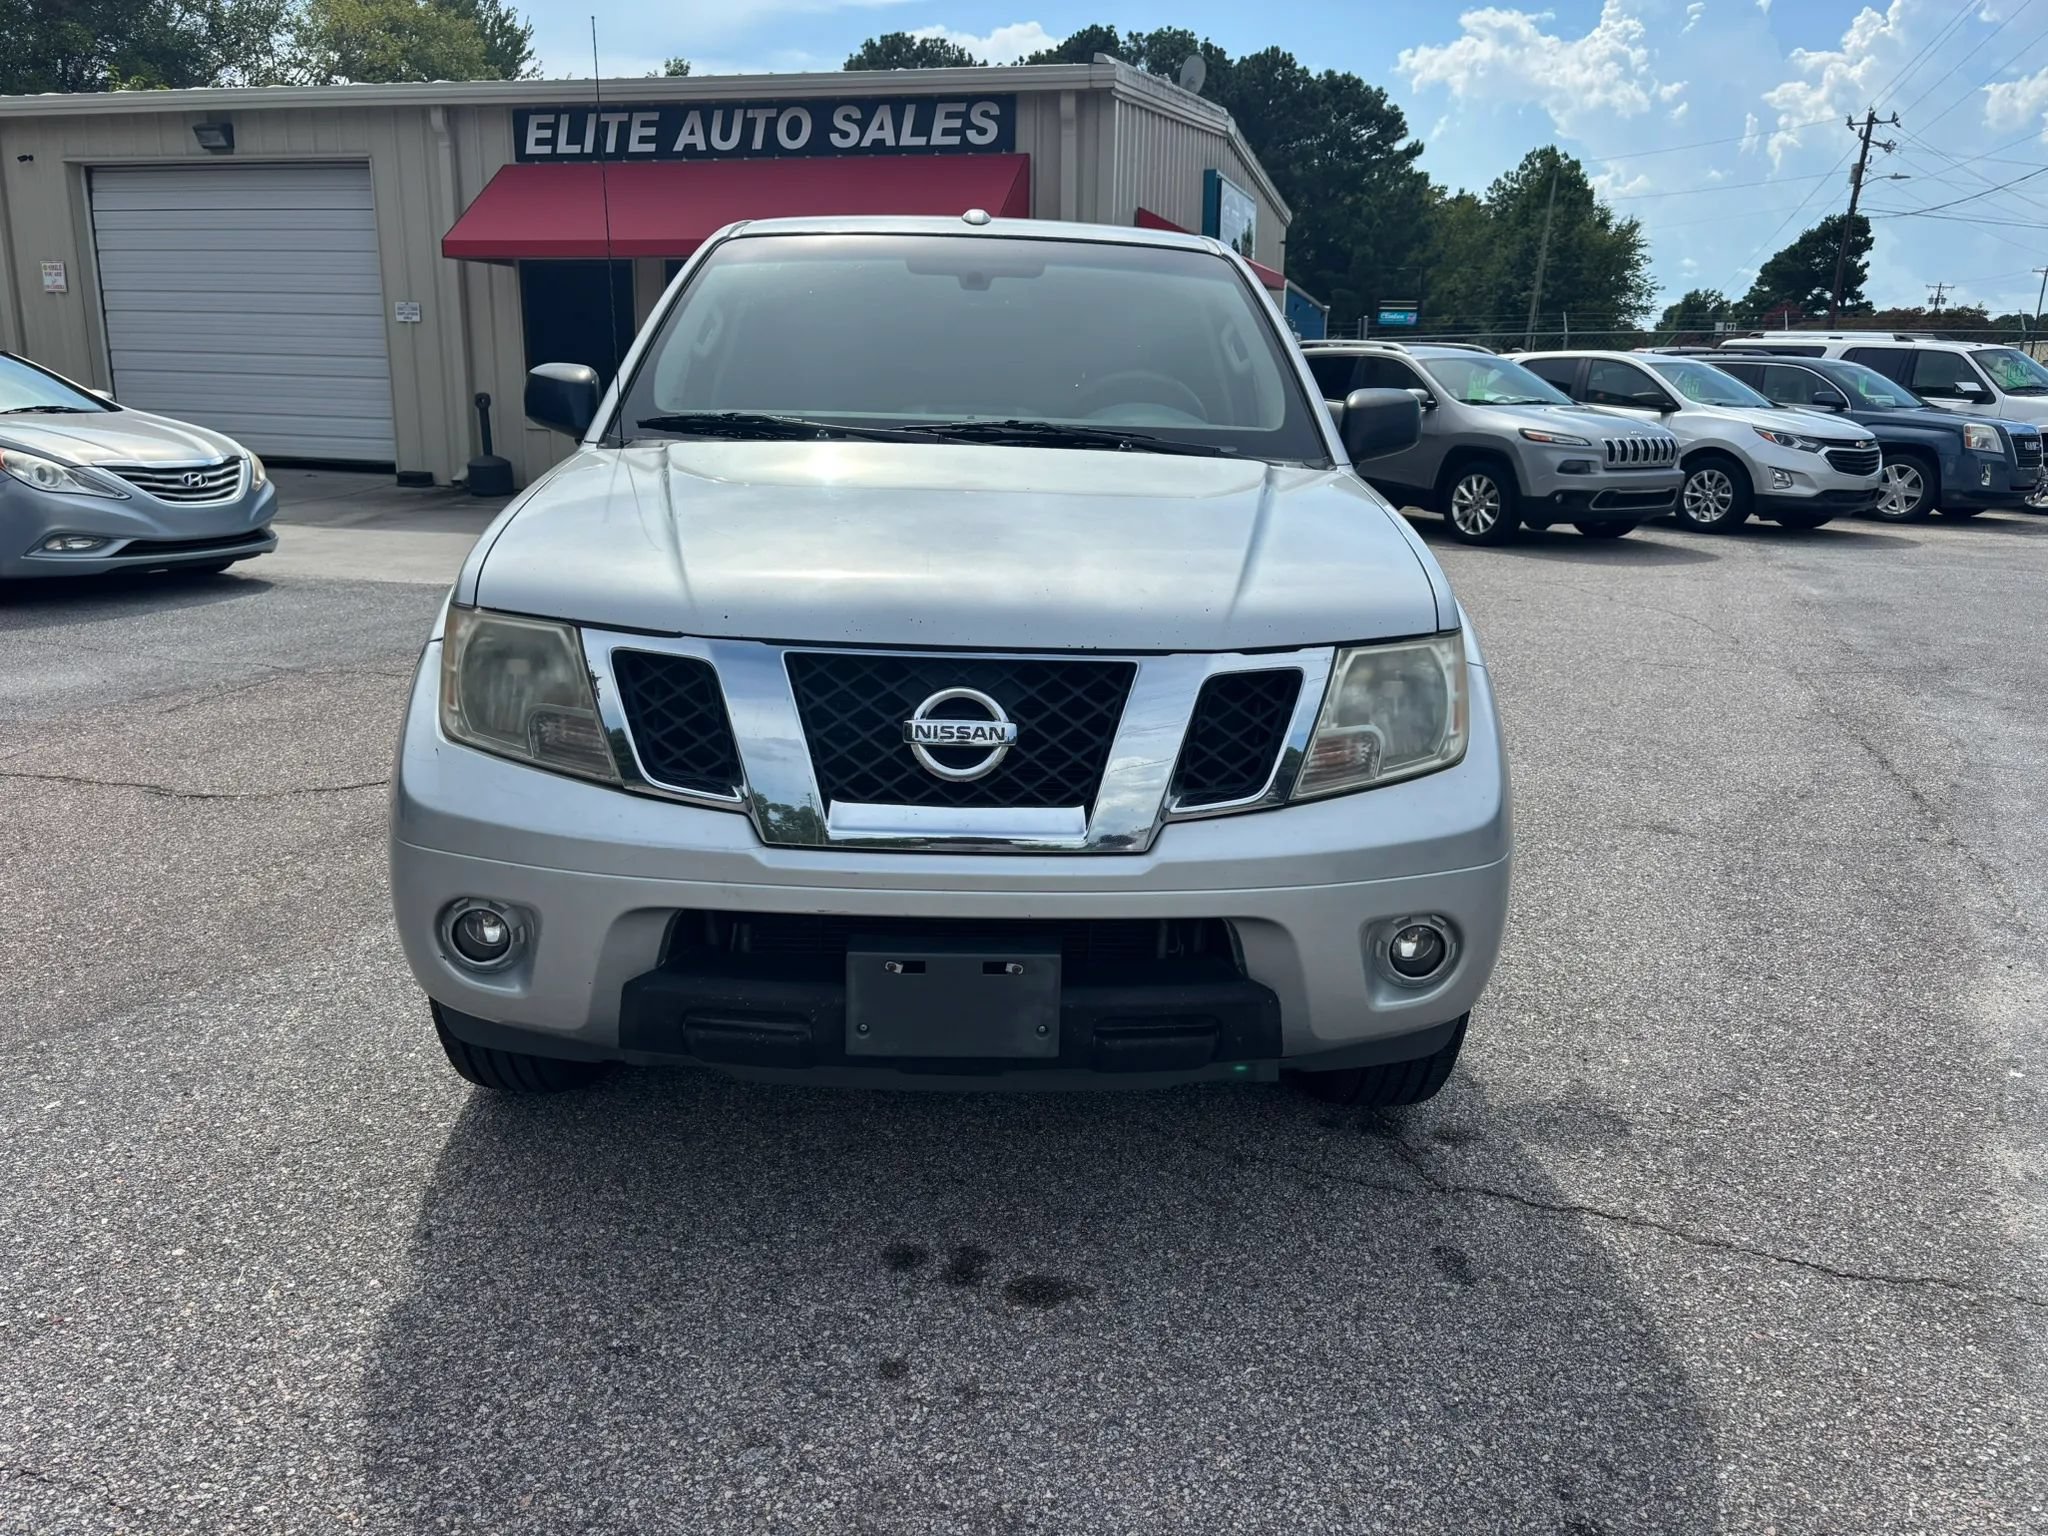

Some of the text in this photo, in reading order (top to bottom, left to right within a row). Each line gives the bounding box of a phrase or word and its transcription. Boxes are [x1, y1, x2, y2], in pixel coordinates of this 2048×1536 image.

[525, 101, 1001, 154] ELITE AUTO SALES
[914, 724, 1006, 741] NISSAN
